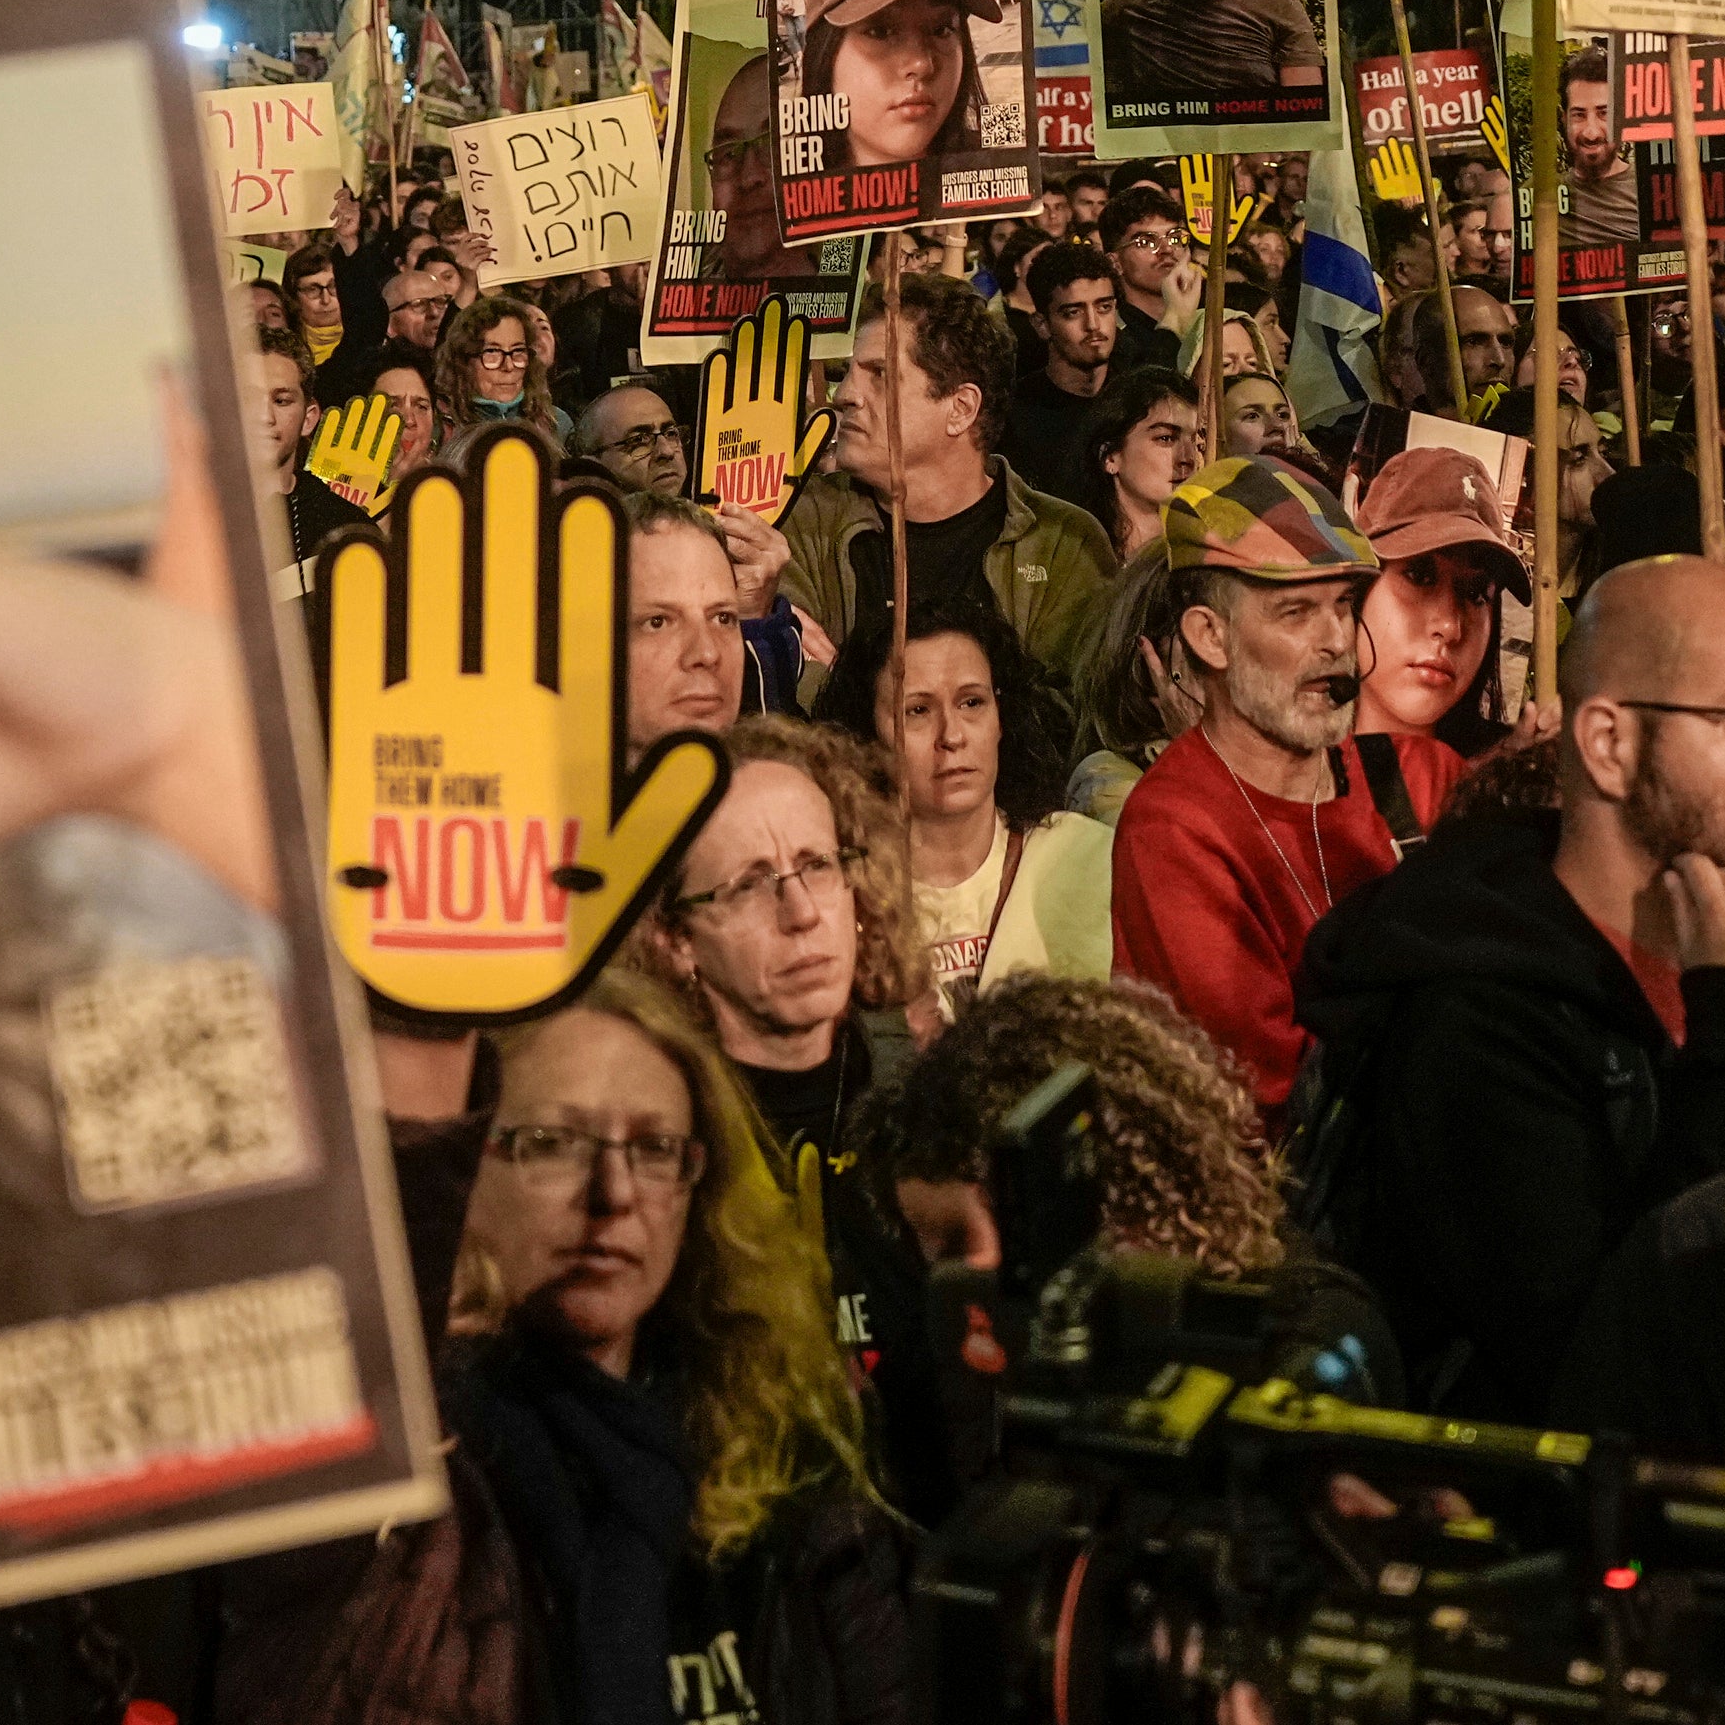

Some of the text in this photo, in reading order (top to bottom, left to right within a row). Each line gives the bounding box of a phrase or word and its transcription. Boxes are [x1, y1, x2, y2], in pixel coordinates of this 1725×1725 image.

[1415, 69, 1428, 85] a
[1432, 65, 1479, 88] year
[778, 92, 851, 136] BRING
[1036, 87, 1062, 107] alf
[1063, 91, 1076, 106] a
[1111, 97, 1324, 118] BRING HIM HOME NOW!
[1367, 89, 1485, 132] of hell
[252, 97, 323, 169] אין
[507, 117, 627, 171] רוצים
[1038, 115, 1095, 147] f he
[780, 135, 825, 176] HER
[524, 160, 638, 217] אותם
[782, 162, 919, 219] HOME NOW!
[941, 165, 1029, 185] HOSTAGES AND MISSING
[941, 178, 1030, 204] FAMILIES FORUM
[523, 210, 633, 263] חיים!
[669, 209, 728, 244] BRING
[663, 245, 703, 280] HIM
[1575, 242, 1626, 281] NOW!
[658, 283, 714, 318] HOME
[818, 303, 847, 319] FORUM
[717, 439, 762, 462] THEM HOME
[718, 428, 743, 447] BRING
[329, 481, 369, 506] OW
[714, 452, 786, 510] NOW
[375, 733, 443, 768] BRING
[440, 772, 502, 806] HOME
[372, 817, 580, 923] NOW
